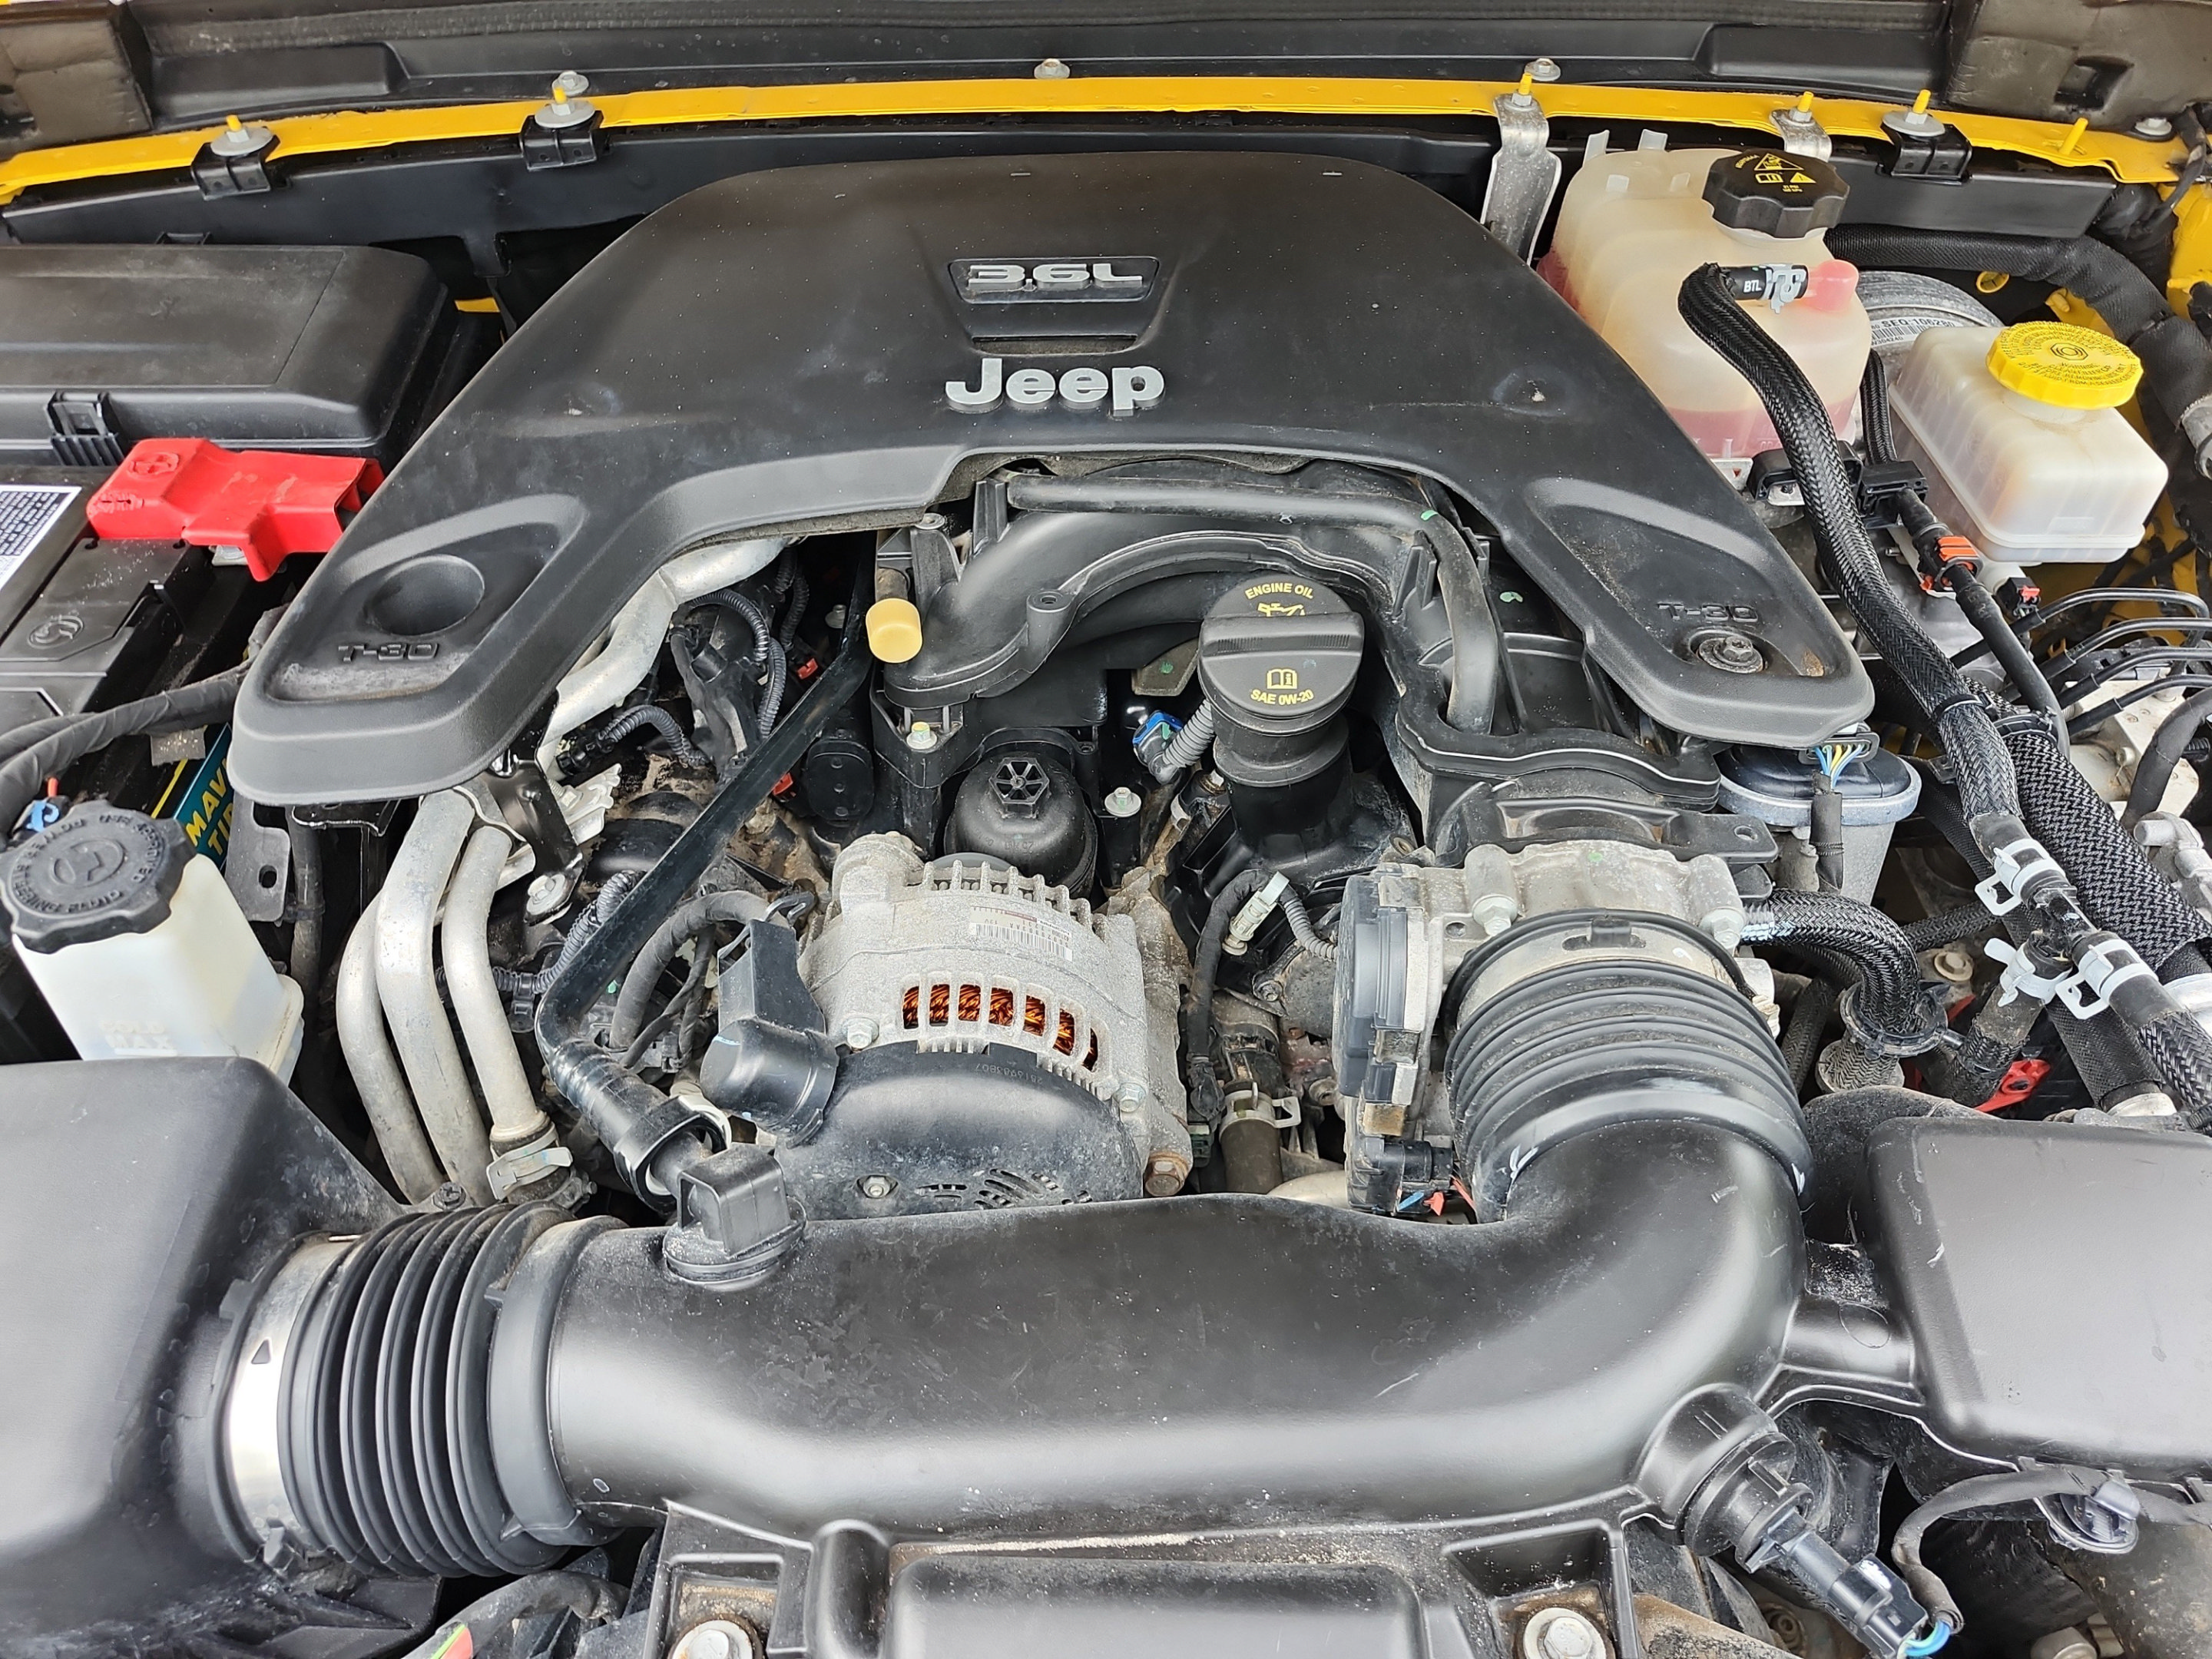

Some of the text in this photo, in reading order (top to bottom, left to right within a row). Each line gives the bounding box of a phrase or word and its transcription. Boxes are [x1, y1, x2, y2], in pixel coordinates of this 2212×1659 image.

[968, 263, 1143, 291] 3.6L
[1743, 280, 1762, 293] BTL
[945, 358, 1165, 416] Jeep
[1244, 583, 1313, 599] ENGINE OIL
[1657, 602, 1758, 623] T-30
[338, 643, 439, 661] T-30
[1250, 689, 1314, 705] SAE 0W-20
[186, 758, 227, 847] MAV
[105, 1034, 174, 1048] MAX
